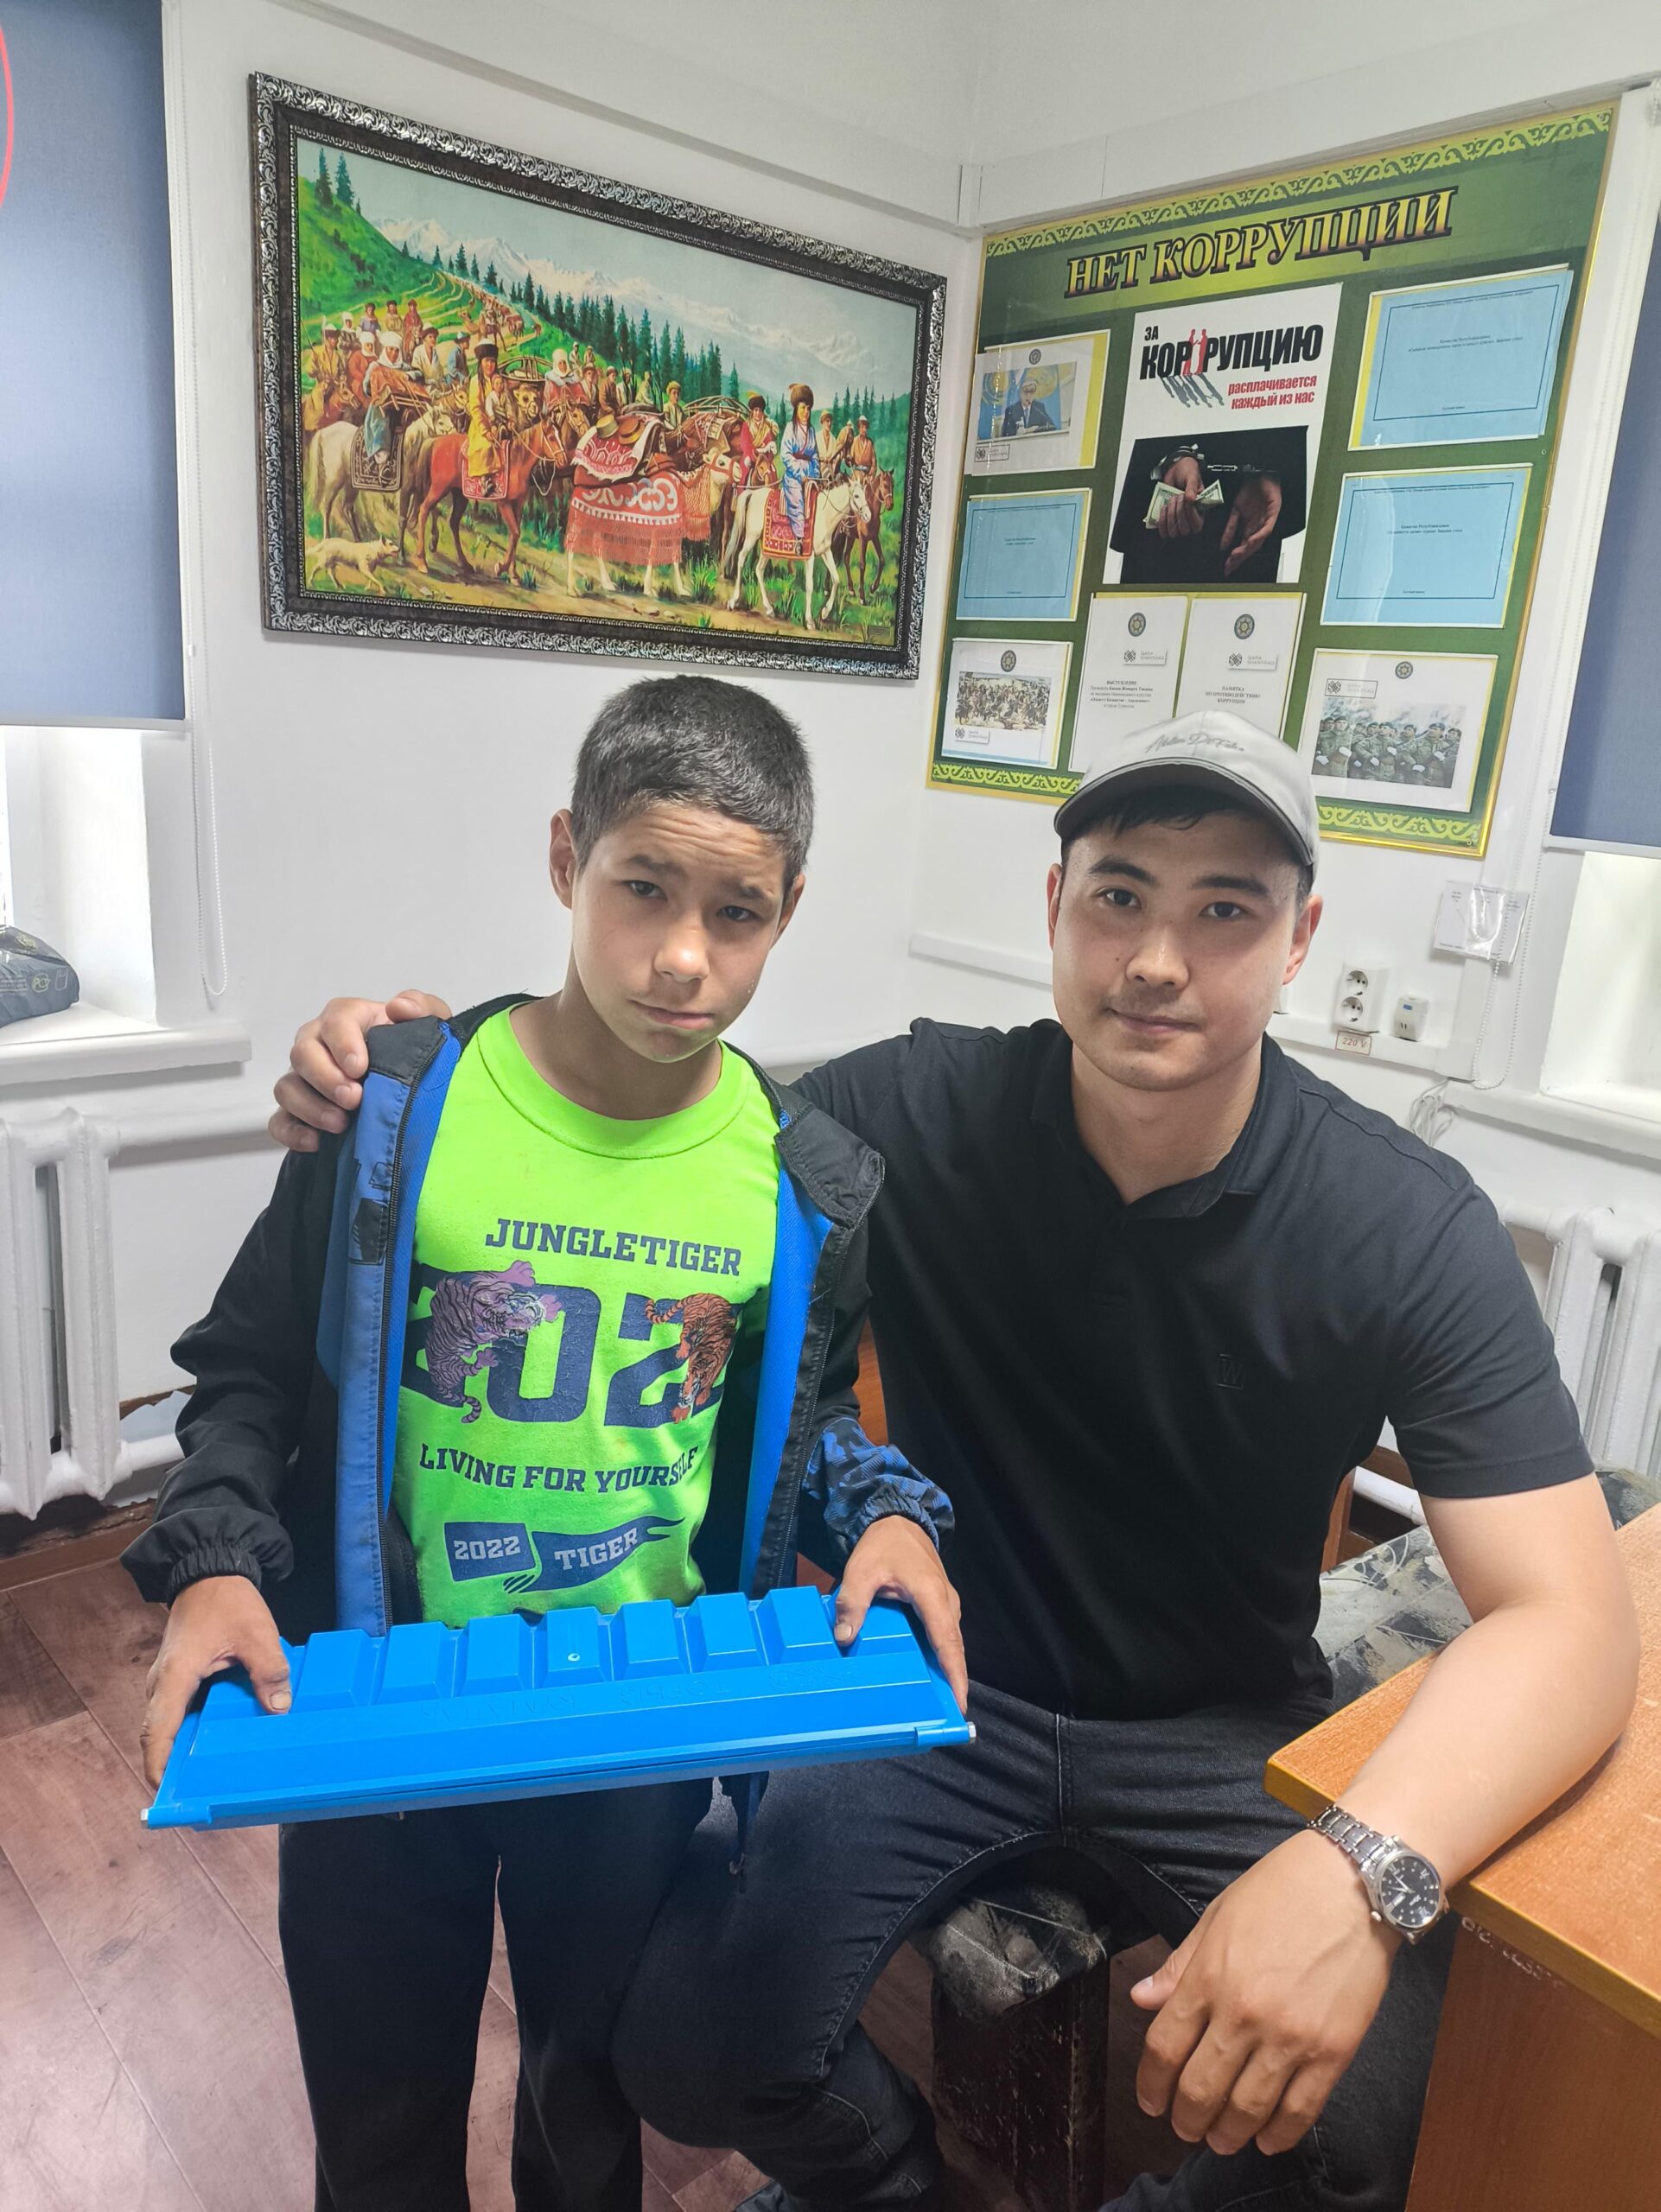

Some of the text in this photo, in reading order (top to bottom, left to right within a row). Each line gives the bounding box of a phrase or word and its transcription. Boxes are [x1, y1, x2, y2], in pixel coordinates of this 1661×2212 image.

[1064, 185, 1460, 298] НЕТ КОРРУПЦИИ
[1139, 324, 1324, 380] КОРРУПЦИЮ
[1144, 326, 1159, 341] ЗА
[1227, 375, 1318, 396] расплачивается
[1231, 391, 1315, 410] каждый из нас
[1342, 1037, 1358, 1046] 220
[485, 1218, 741, 1276] JUNGLETIGER
[419, 1443, 698, 1493] LIVING FOR YOURSELF
[453, 1527, 638, 1570] 2022 TIGER
